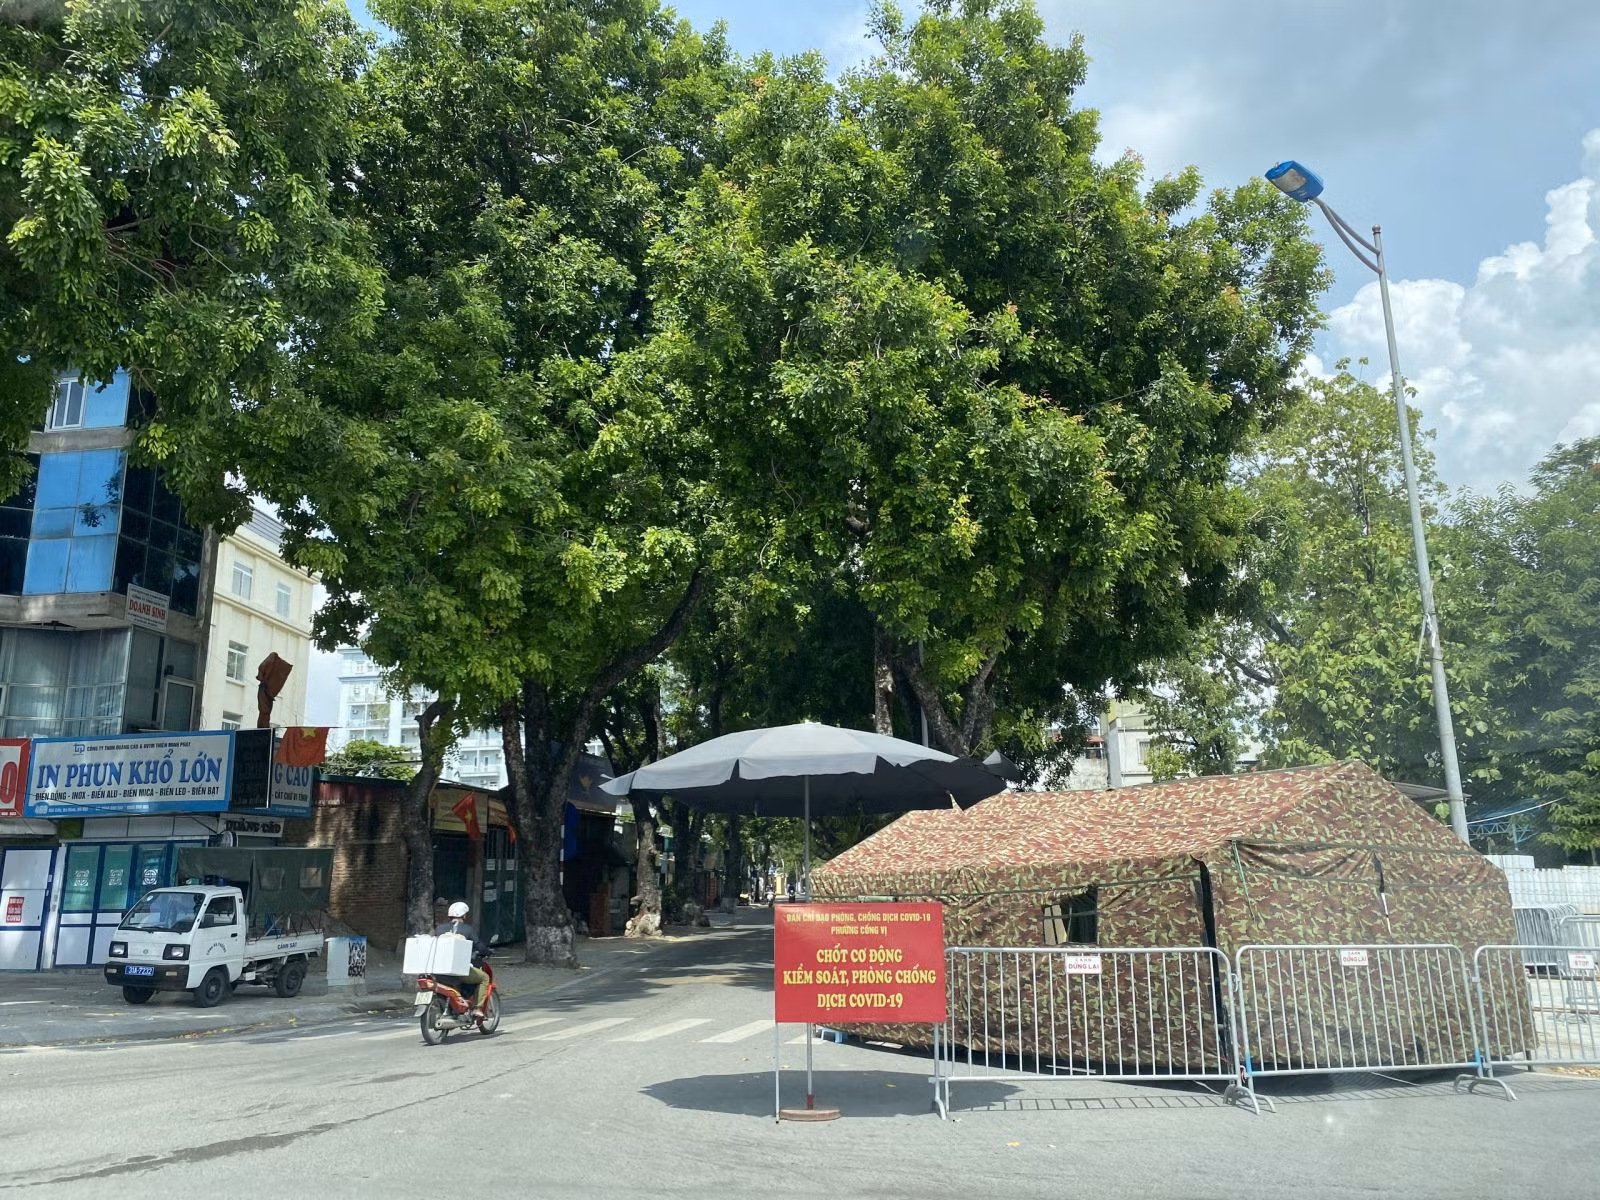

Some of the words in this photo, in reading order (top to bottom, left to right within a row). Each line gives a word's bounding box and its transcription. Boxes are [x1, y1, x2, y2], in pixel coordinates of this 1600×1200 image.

[36, 764, 61, 789] IN
[65, 761, 124, 788] PHUN
[128, 748, 174, 786] KHỔ
[179, 751, 223, 784] LỚN
[786, 913, 801, 922] BAN
[858, 910, 881, 922] CHỐNG
[882, 913, 899, 924] DỊCH
[900, 913, 931, 922] COVID-19
[831, 924, 859, 935] PHƯỜNG
[860, 923, 879, 935] CỐNG
[880, 926, 888, 937] VỊ
[816, 943, 848, 963] CHỐT
[850, 947, 867, 963] CƠ
[869, 944, 903, 966] ĐỘNG
[783, 962, 814, 985] KIỂM
[815, 966, 849, 987] SOÁT,
[851, 966, 893, 984] PHÒNG
[895, 963, 937, 984] CHỐNG
[817, 993, 847, 1011] DỊCH
[849, 992, 904, 1009] COVID-19
